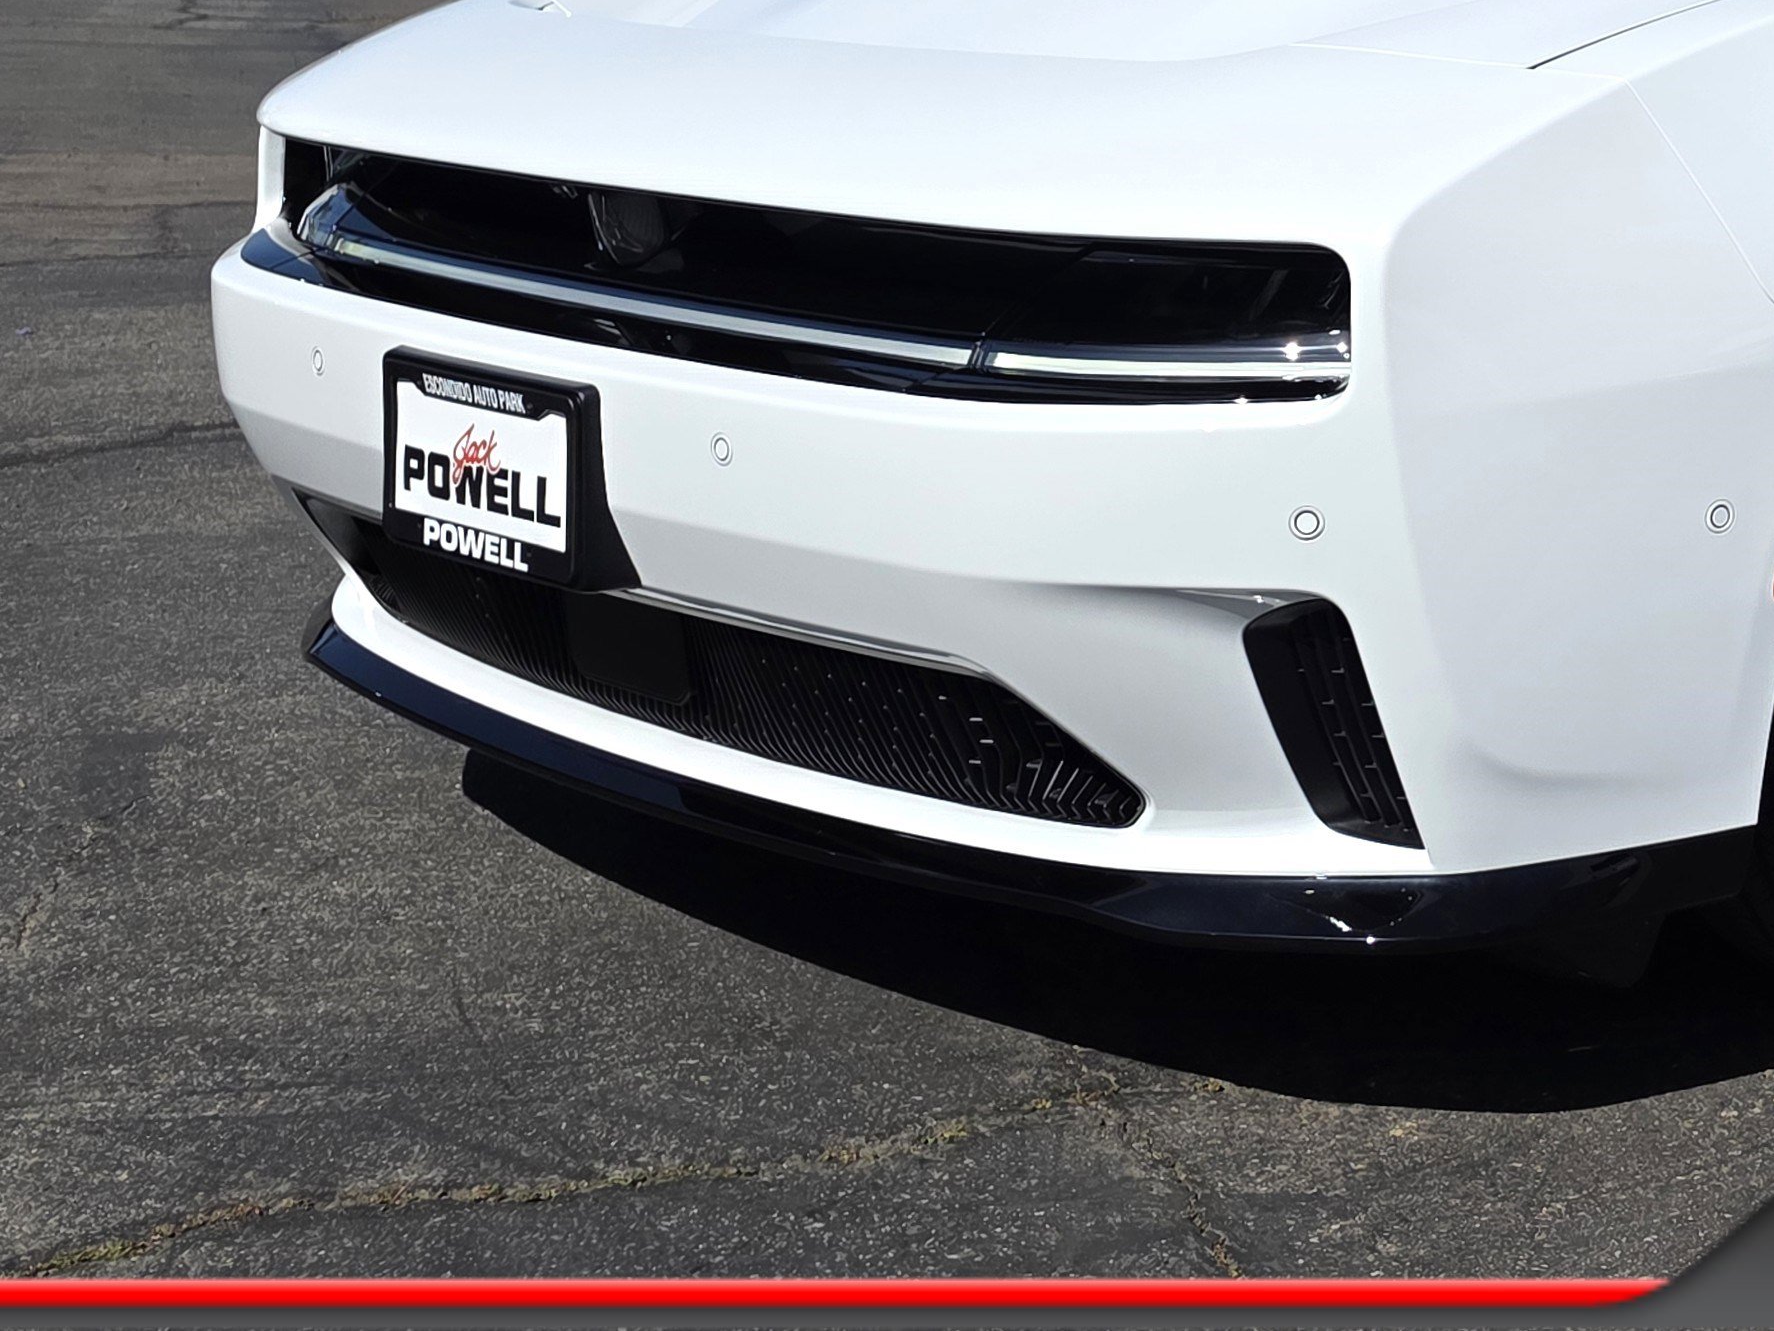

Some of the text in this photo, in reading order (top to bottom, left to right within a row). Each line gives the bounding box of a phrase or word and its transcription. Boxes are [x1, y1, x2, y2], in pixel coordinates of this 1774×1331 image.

[422, 372, 527, 414] ESCONDIDO AUTO PARK
[452, 423, 501, 485] Jack
[404, 443, 562, 528] POWELL
[423, 517, 529, 572] POWELL
